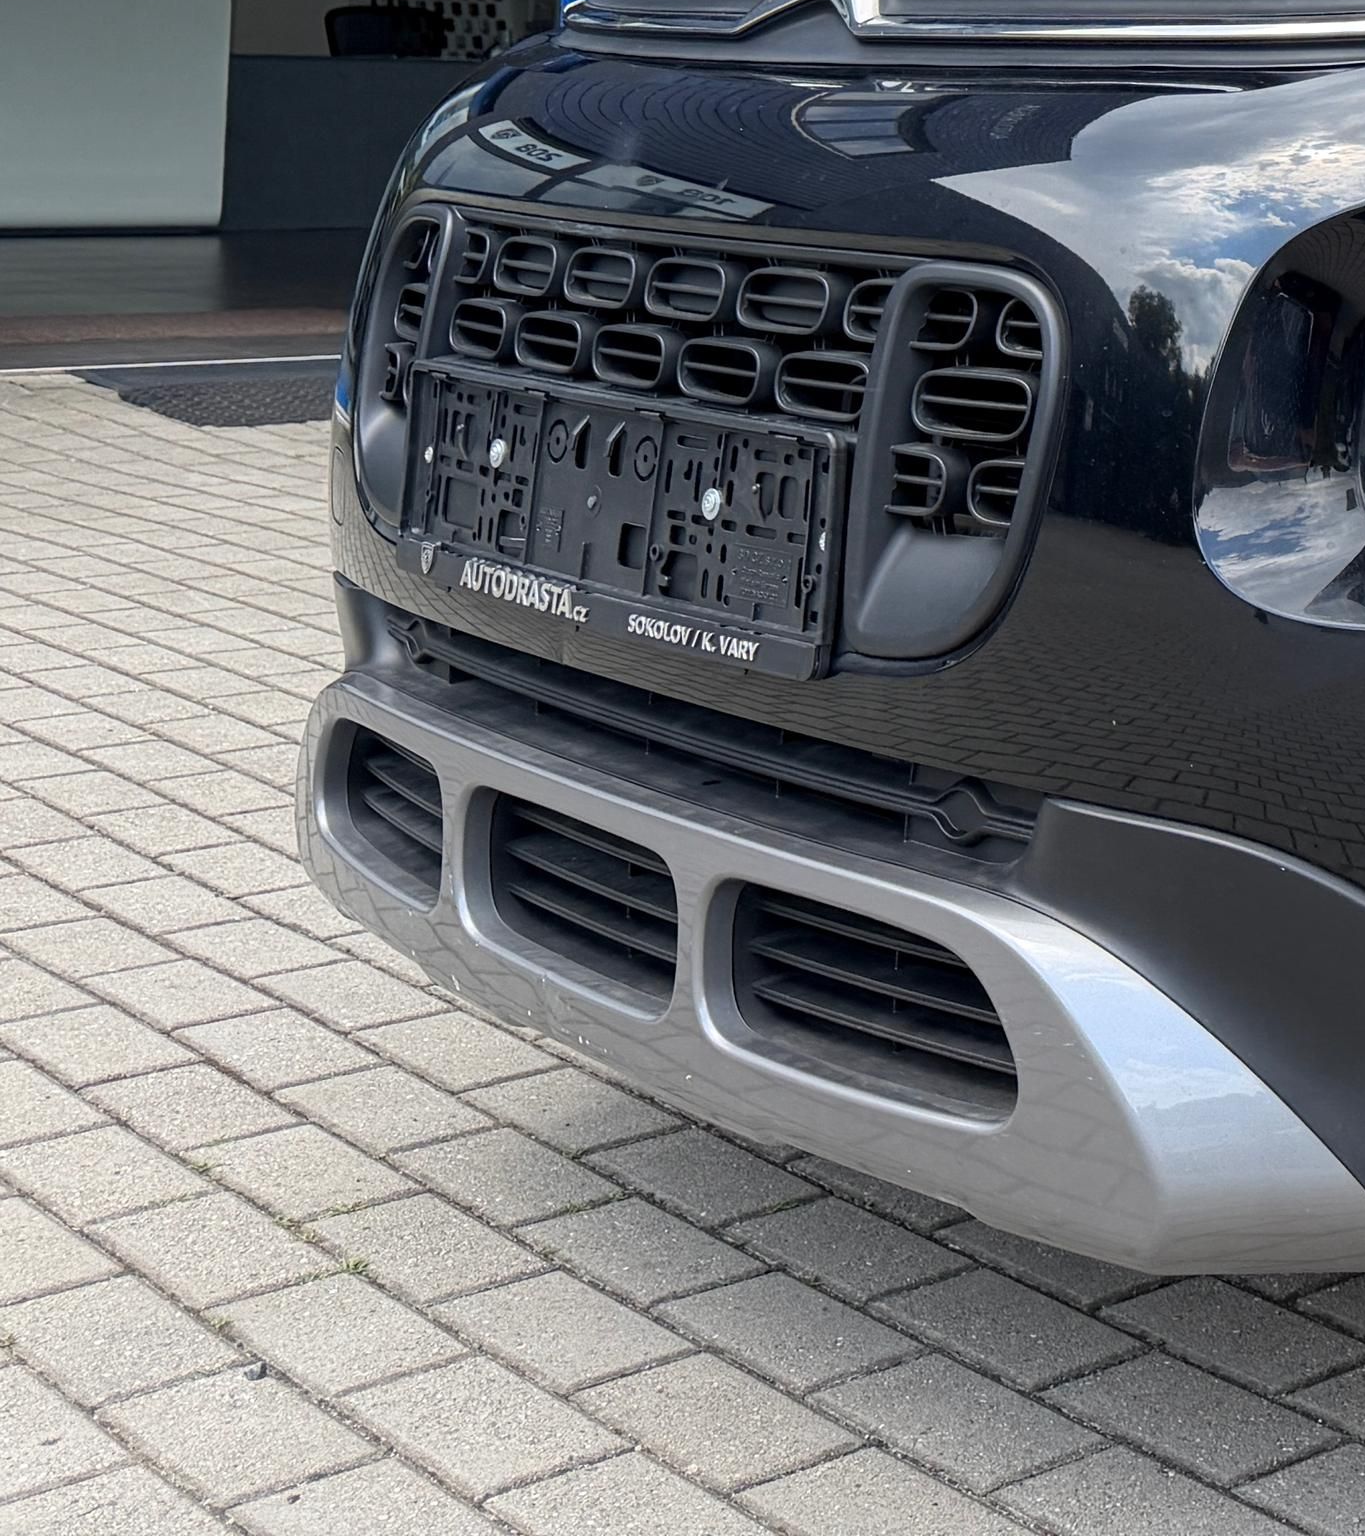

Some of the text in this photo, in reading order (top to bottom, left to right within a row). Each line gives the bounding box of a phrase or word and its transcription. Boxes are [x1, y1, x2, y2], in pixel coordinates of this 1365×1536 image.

[459, 558, 591, 624] AUTODRASTA.cz
[627, 613, 692, 648] SOKOLOV
[719, 635, 761, 662] VARY
